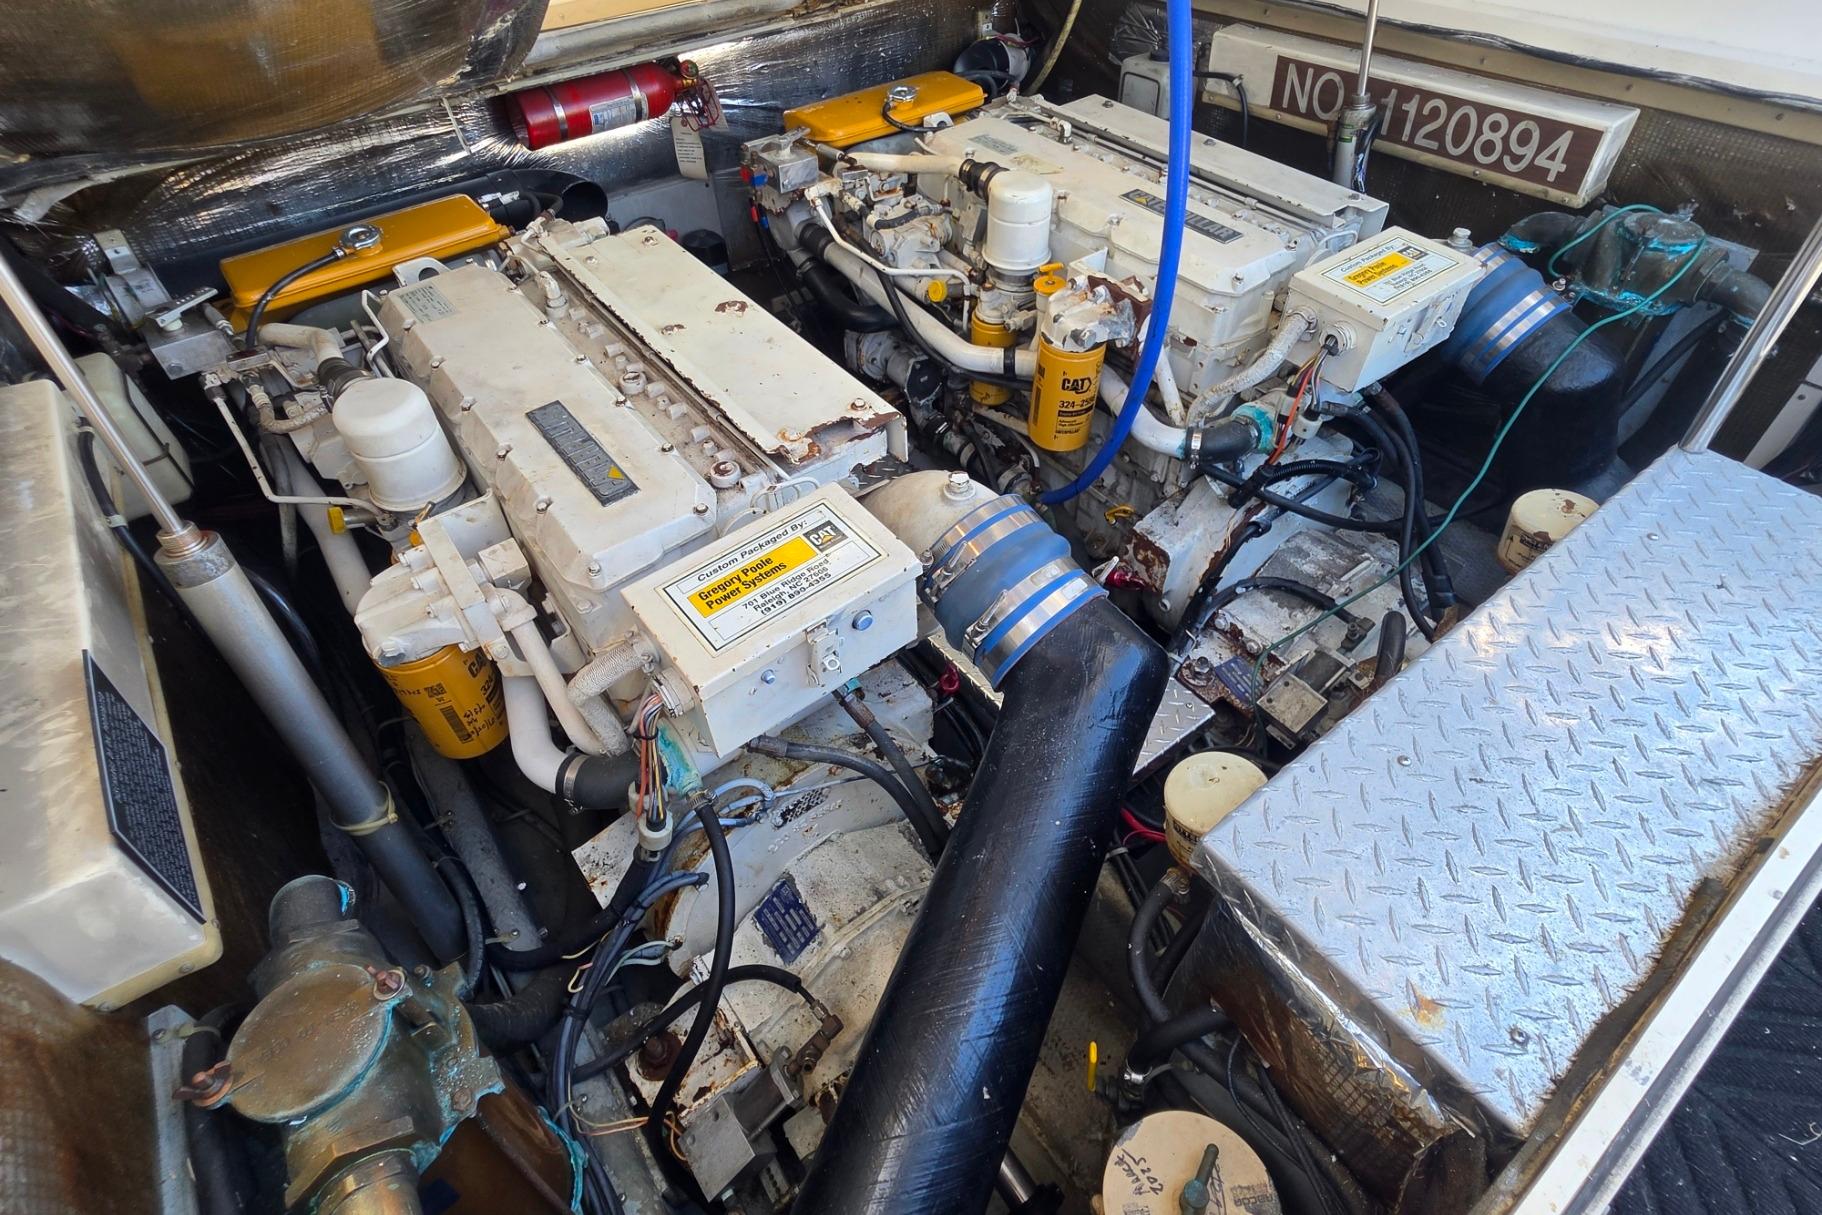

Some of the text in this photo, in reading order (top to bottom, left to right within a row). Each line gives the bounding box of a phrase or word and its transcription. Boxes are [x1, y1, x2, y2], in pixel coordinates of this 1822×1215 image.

[1282, 63, 1574, 182] NO 1120894
[1061, 377, 1089, 393] CAT
[809, 525, 837, 546] CAT
[697, 520, 808, 582] Custom Packaged By:
[698, 557, 773, 601] Gregory Poole
[705, 562, 787, 609] Power Systems
[760, 586, 780, 600] Blue
[780, 572, 806, 588] Ridge
[788, 580, 803, 590] NC
[761, 598, 787, 615] (919)
